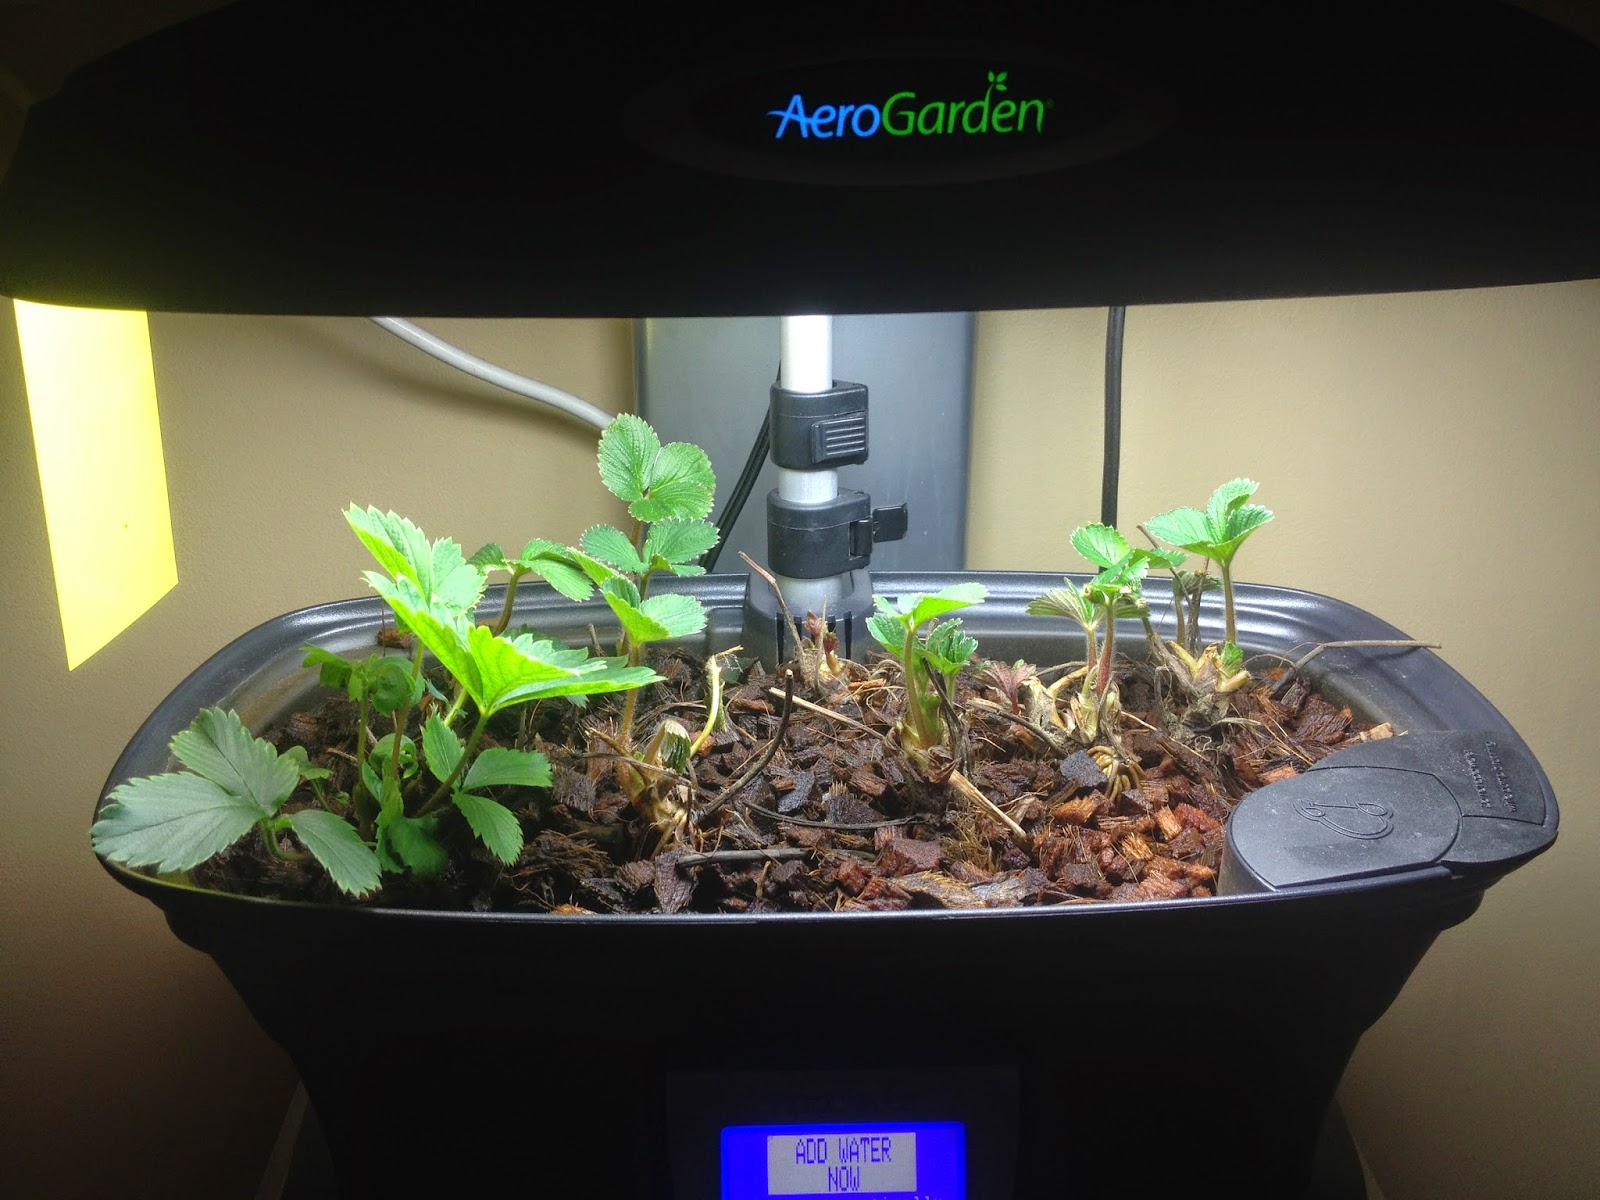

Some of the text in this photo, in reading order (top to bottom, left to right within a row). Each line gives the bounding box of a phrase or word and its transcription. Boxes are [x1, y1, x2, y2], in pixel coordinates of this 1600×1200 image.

[766, 78, 1045, 138] AeroGarden
[796, 1137, 891, 1164] ADD WATER
[828, 1166, 859, 1192] NOW
